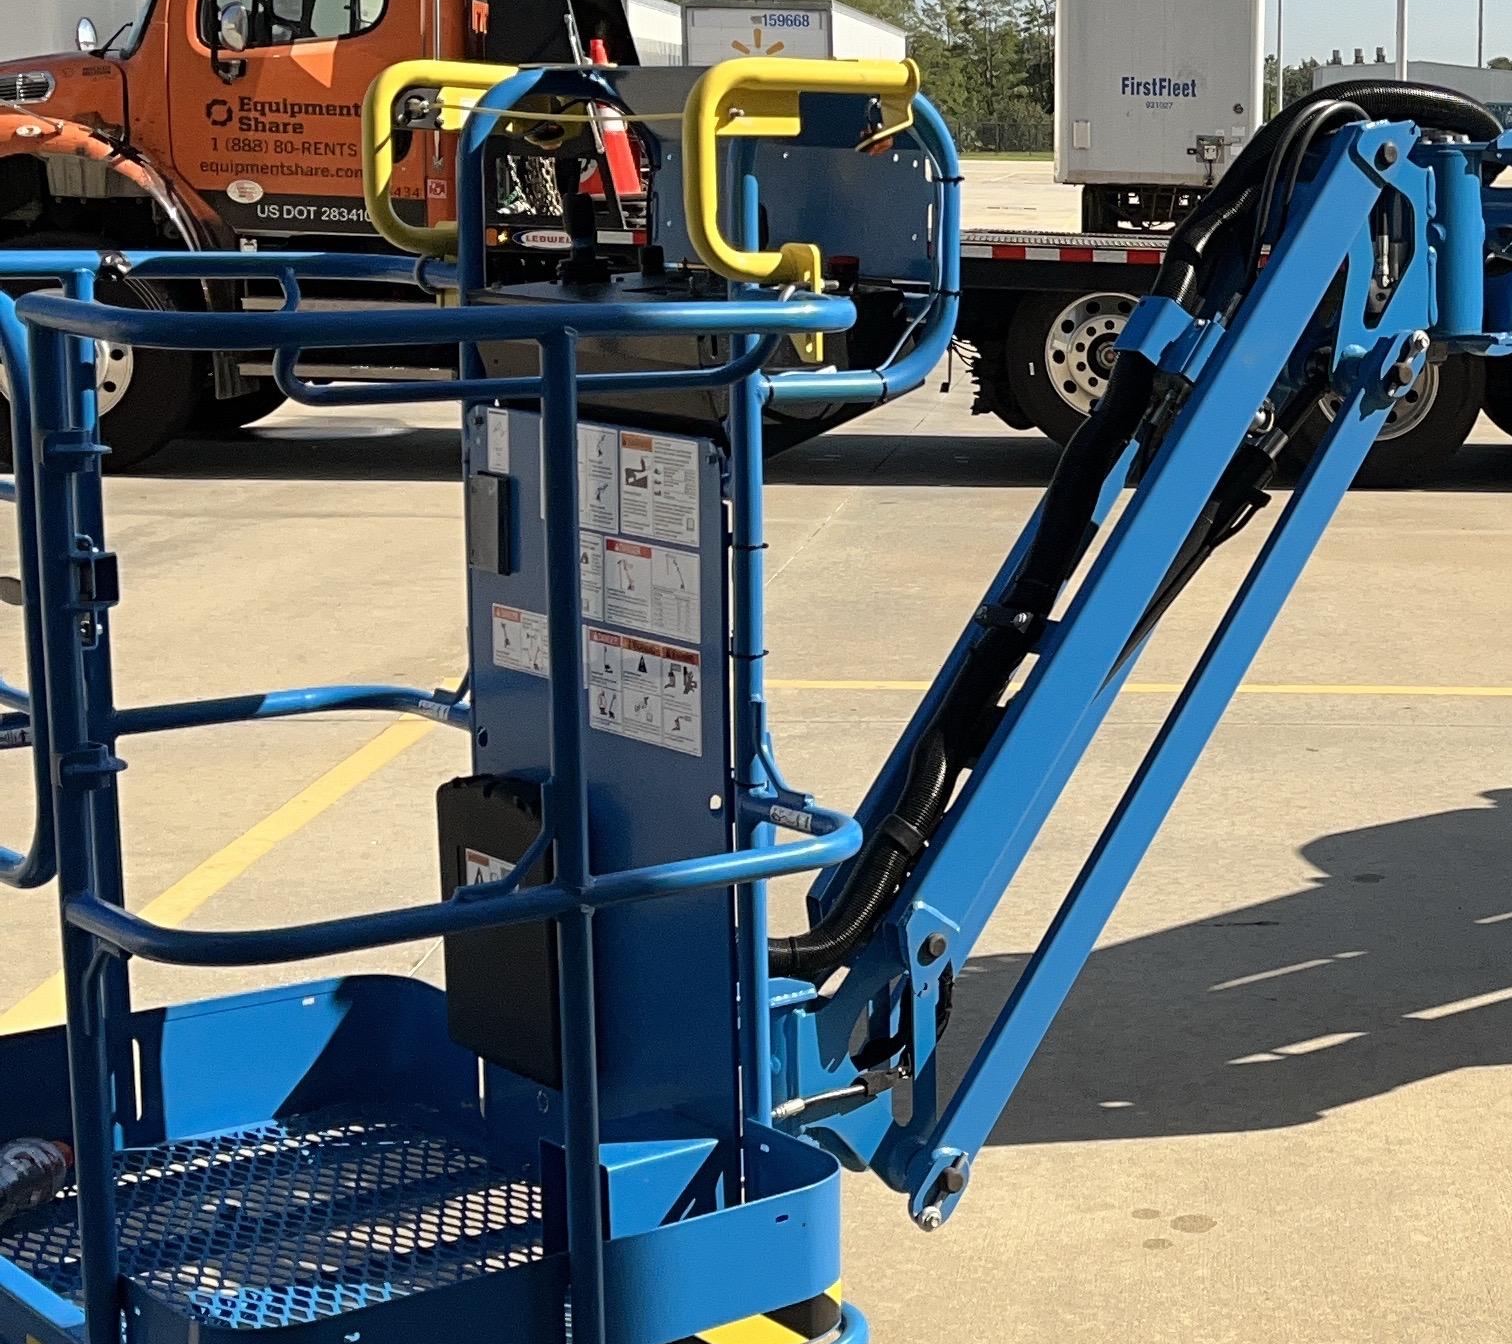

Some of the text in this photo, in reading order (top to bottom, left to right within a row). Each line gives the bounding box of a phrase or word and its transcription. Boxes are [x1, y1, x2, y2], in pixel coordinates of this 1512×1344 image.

[762, 13, 810, 28] 159668
[1121, 76, 1197, 98] FirstFleet
[238, 96, 362, 119] Equipment
[238, 115, 305, 134] Share
[211, 137, 358, 157] 1 (888) 80-RENTS
[256, 204, 280, 219] US
[283, 205, 317, 220] DOT
